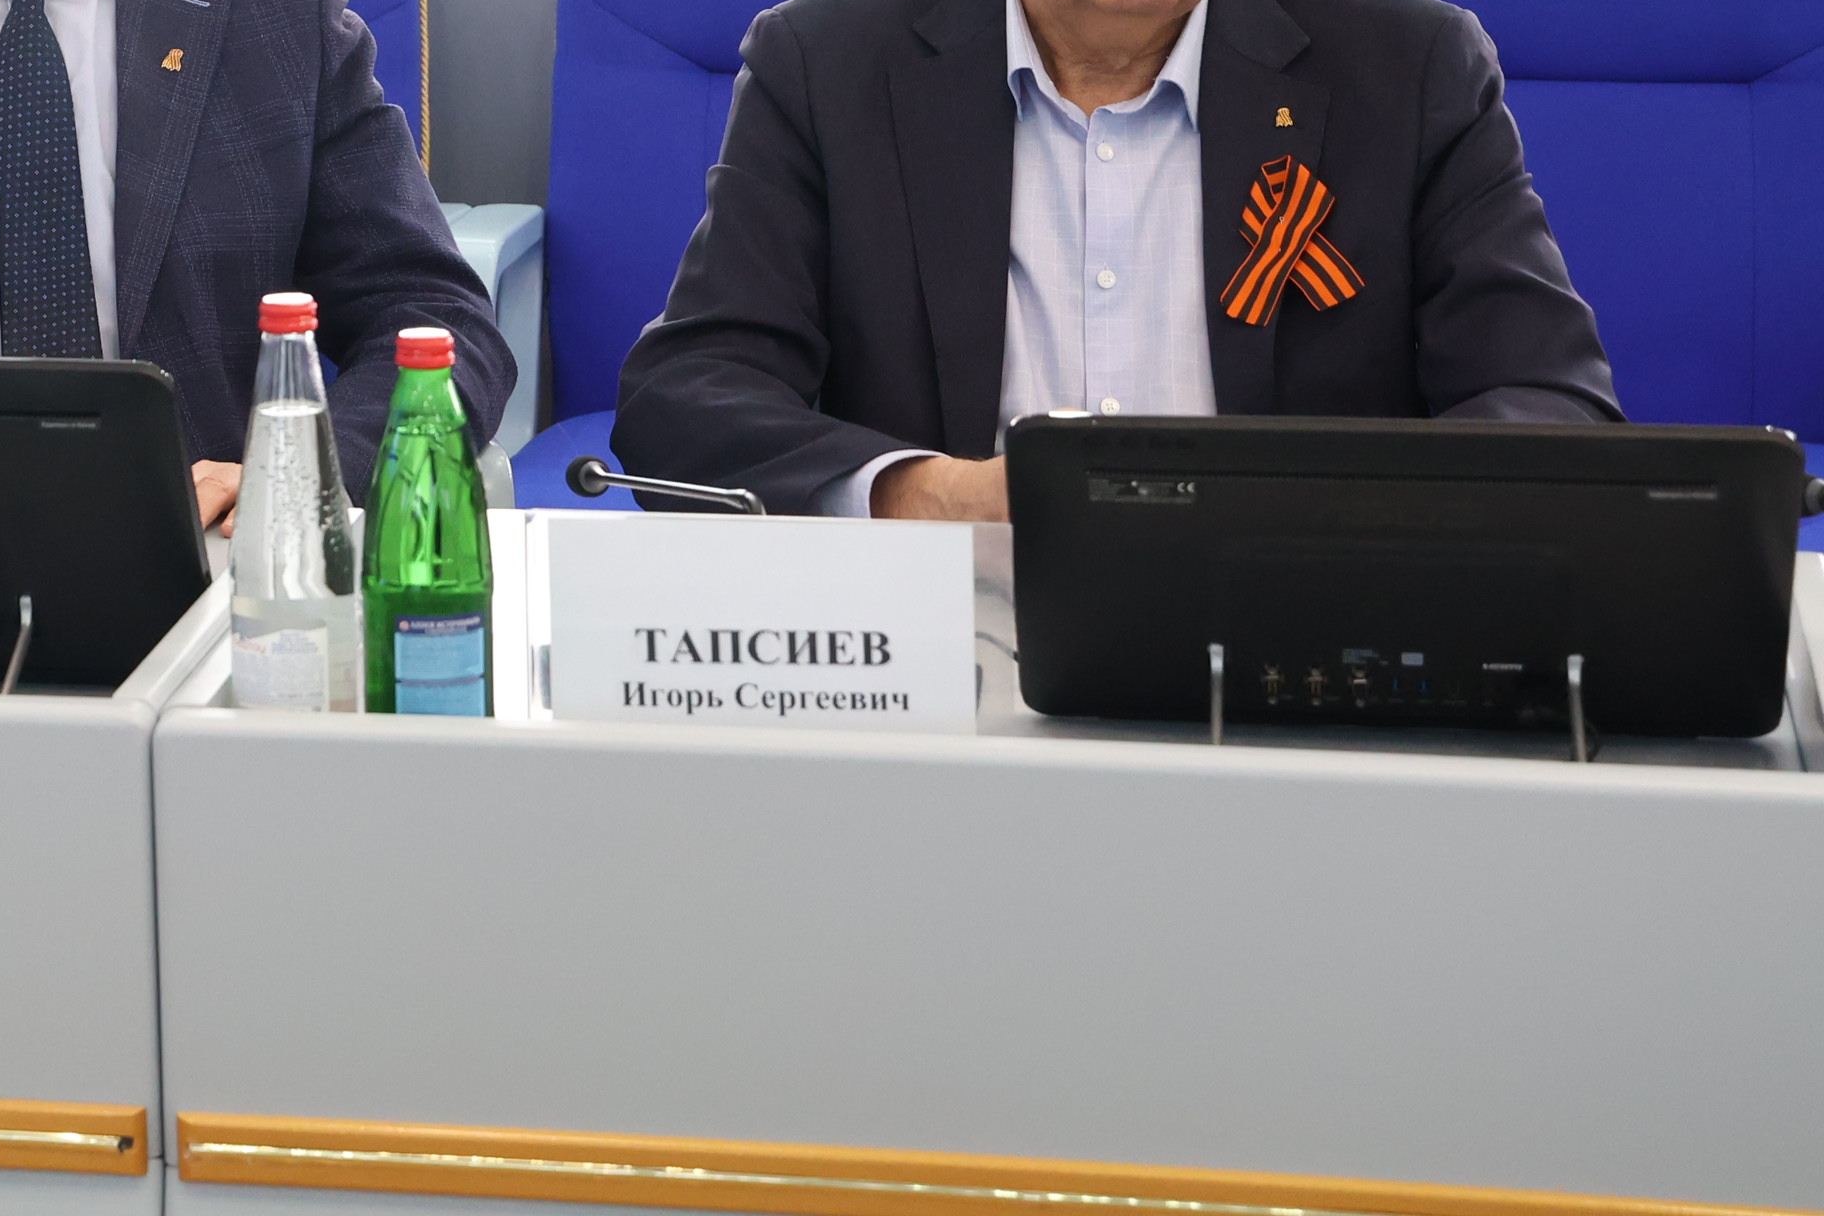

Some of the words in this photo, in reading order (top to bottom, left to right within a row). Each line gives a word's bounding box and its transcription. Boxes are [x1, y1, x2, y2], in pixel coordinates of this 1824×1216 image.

[635, 628, 891, 667] ТАПСИЕВ
[623, 681, 723, 715] Игорь
[735, 684, 910, 717] Сергеевич
